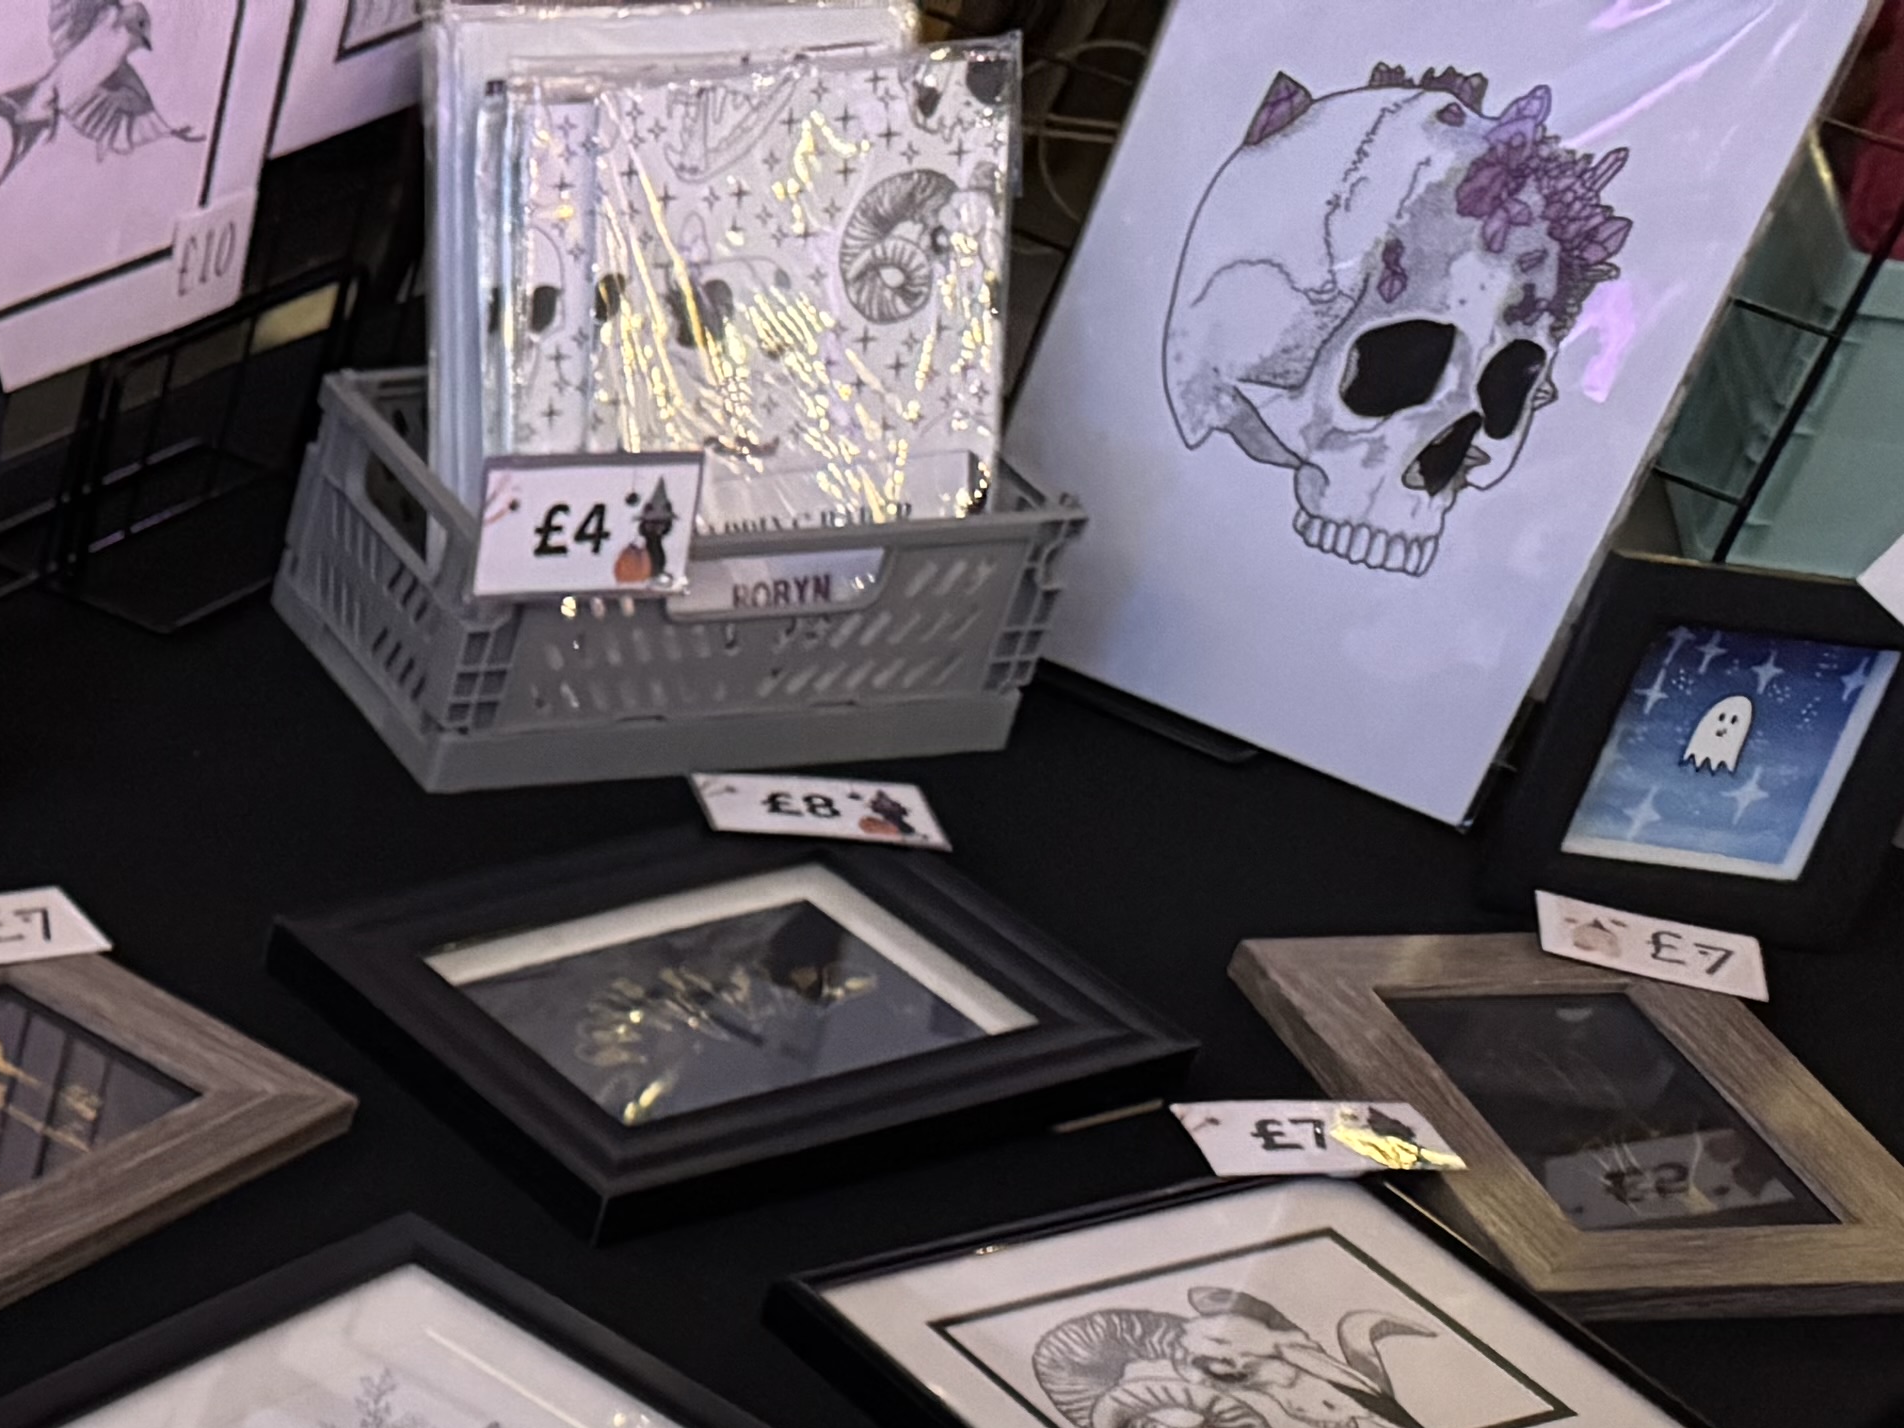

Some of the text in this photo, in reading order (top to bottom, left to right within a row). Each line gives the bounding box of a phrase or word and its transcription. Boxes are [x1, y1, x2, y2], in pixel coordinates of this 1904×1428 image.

[176, 219, 237, 297] £10
[533, 503, 612, 557] £4
[762, 790, 842, 821] £8
[1645, 930, 1738, 977] £7
[1252, 1118, 1327, 1150] £7
